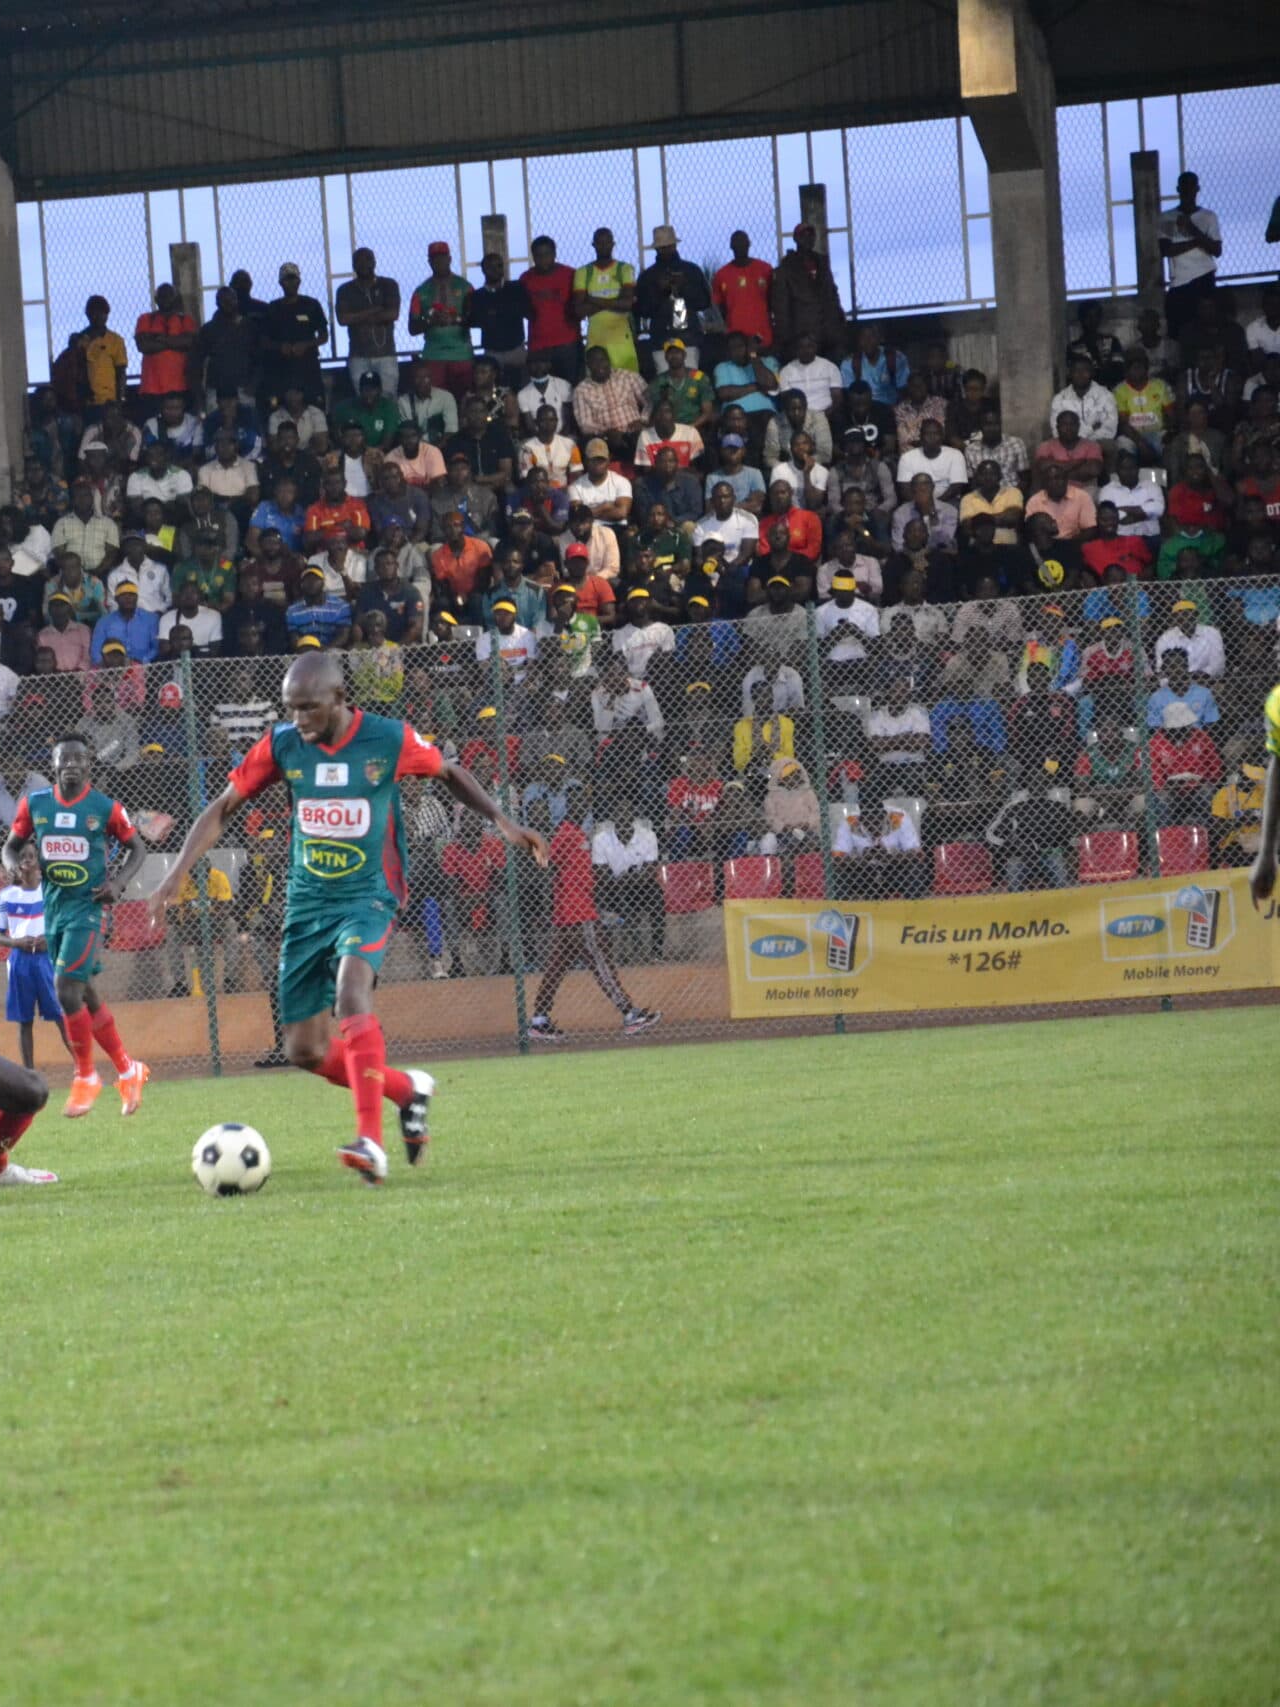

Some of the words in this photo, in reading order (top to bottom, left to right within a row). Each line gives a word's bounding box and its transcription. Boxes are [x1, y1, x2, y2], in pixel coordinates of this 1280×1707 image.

[302, 807, 363, 826] BROLI
[46, 841, 84, 854] BROLI
[311, 849, 348, 868] MTN
[53, 869, 77, 880] MTN
[901, 924, 946, 944] Fais
[952, 927, 982, 942] un
[988, 919, 1070, 940] MoMo.
[1117, 919, 1155, 935] MTN
[760, 940, 796, 954] MTN
[1124, 967, 1170, 980] Mobile
[1174, 964, 1221, 977] Money
[765, 987, 810, 1000] Mobile
[814, 986, 859, 999] Money
